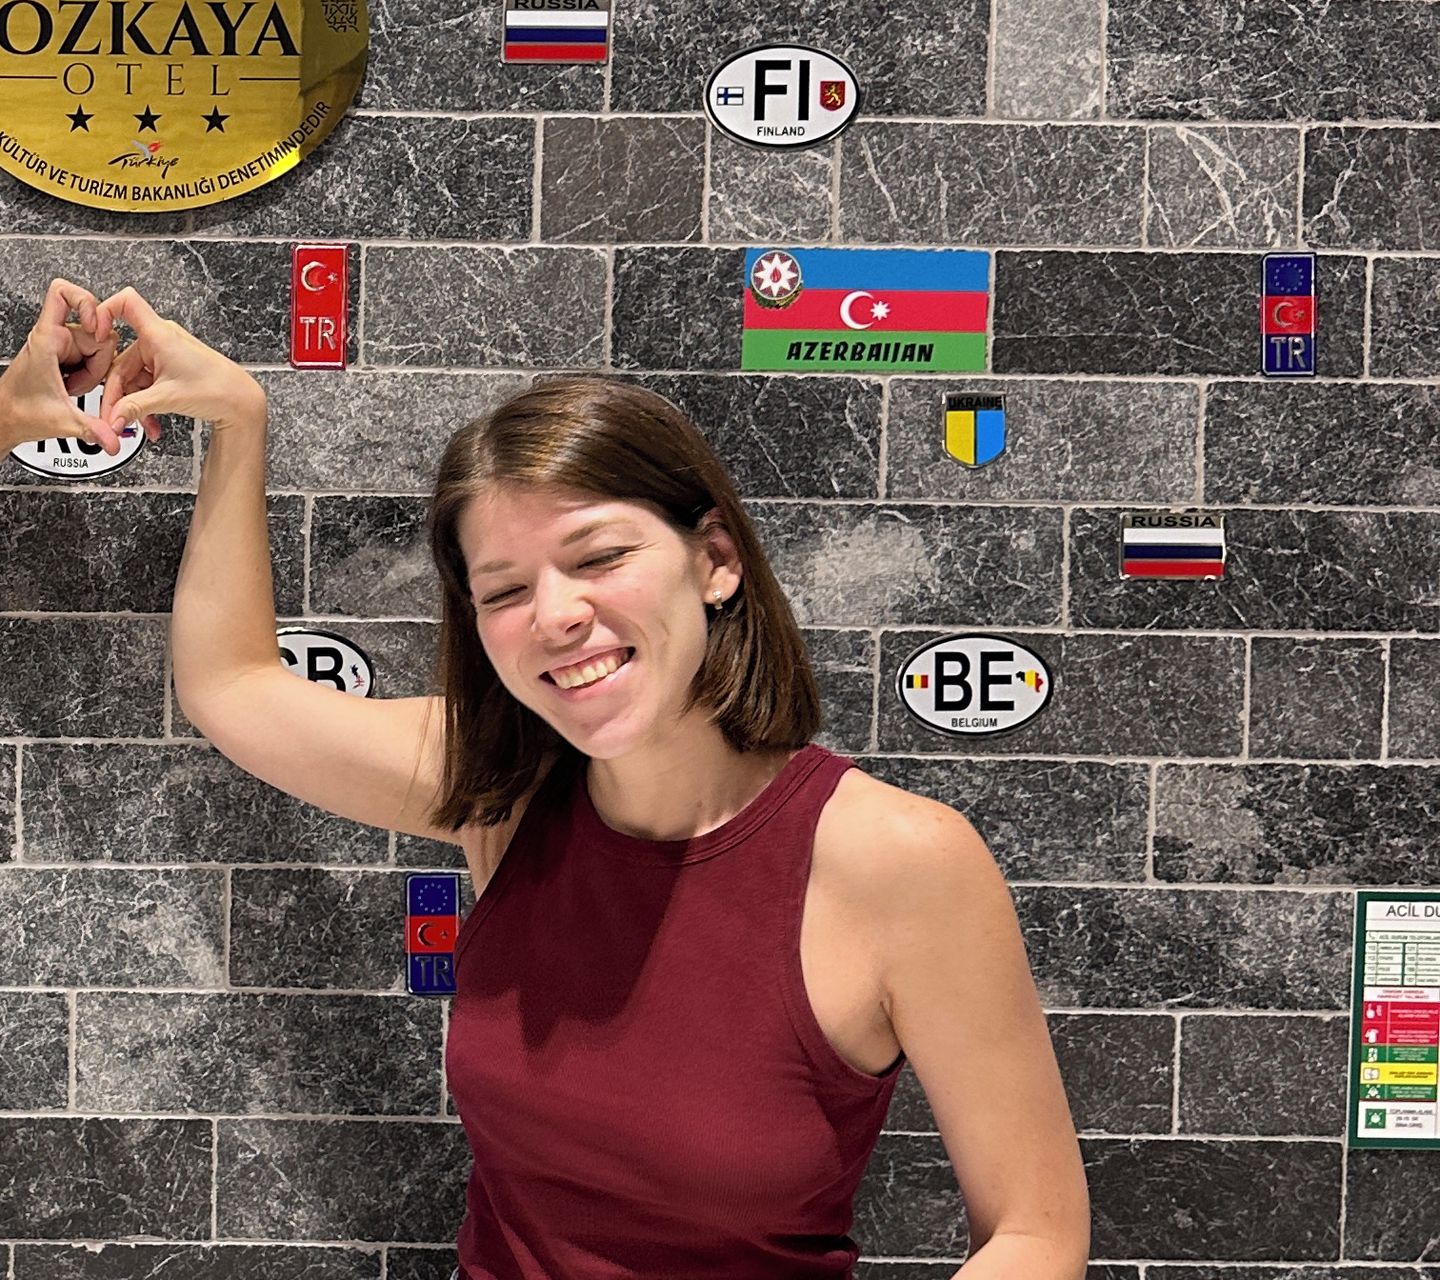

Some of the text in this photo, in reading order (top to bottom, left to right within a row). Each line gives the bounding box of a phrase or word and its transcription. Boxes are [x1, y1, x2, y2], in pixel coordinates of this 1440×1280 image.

[63, 62, 230, 96] OTEL
[753, 59, 811, 122] FI
[756, 126, 806, 137] FINLAND
[107, 152, 180, 180] Türkiye
[49, 165, 69, 186] VE
[70, 173, 128, 200] TURİZM
[132, 177, 216, 201] BAKANLIĞI
[299, 316, 337, 351] TR
[786, 340, 935, 363] AZERBAIJAN
[1269, 335, 1307, 369] TR
[948, 396, 1002, 409] UKRAINE
[53, 457, 89, 469] RUSSIA
[1130, 515, 1217, 529] RUSSIA
[934, 650, 1015, 712] BE
[950, 717, 998, 728] BELGIUM
[1385, 902, 1420, 917] ACİL
[414, 955, 451, 987] TR
